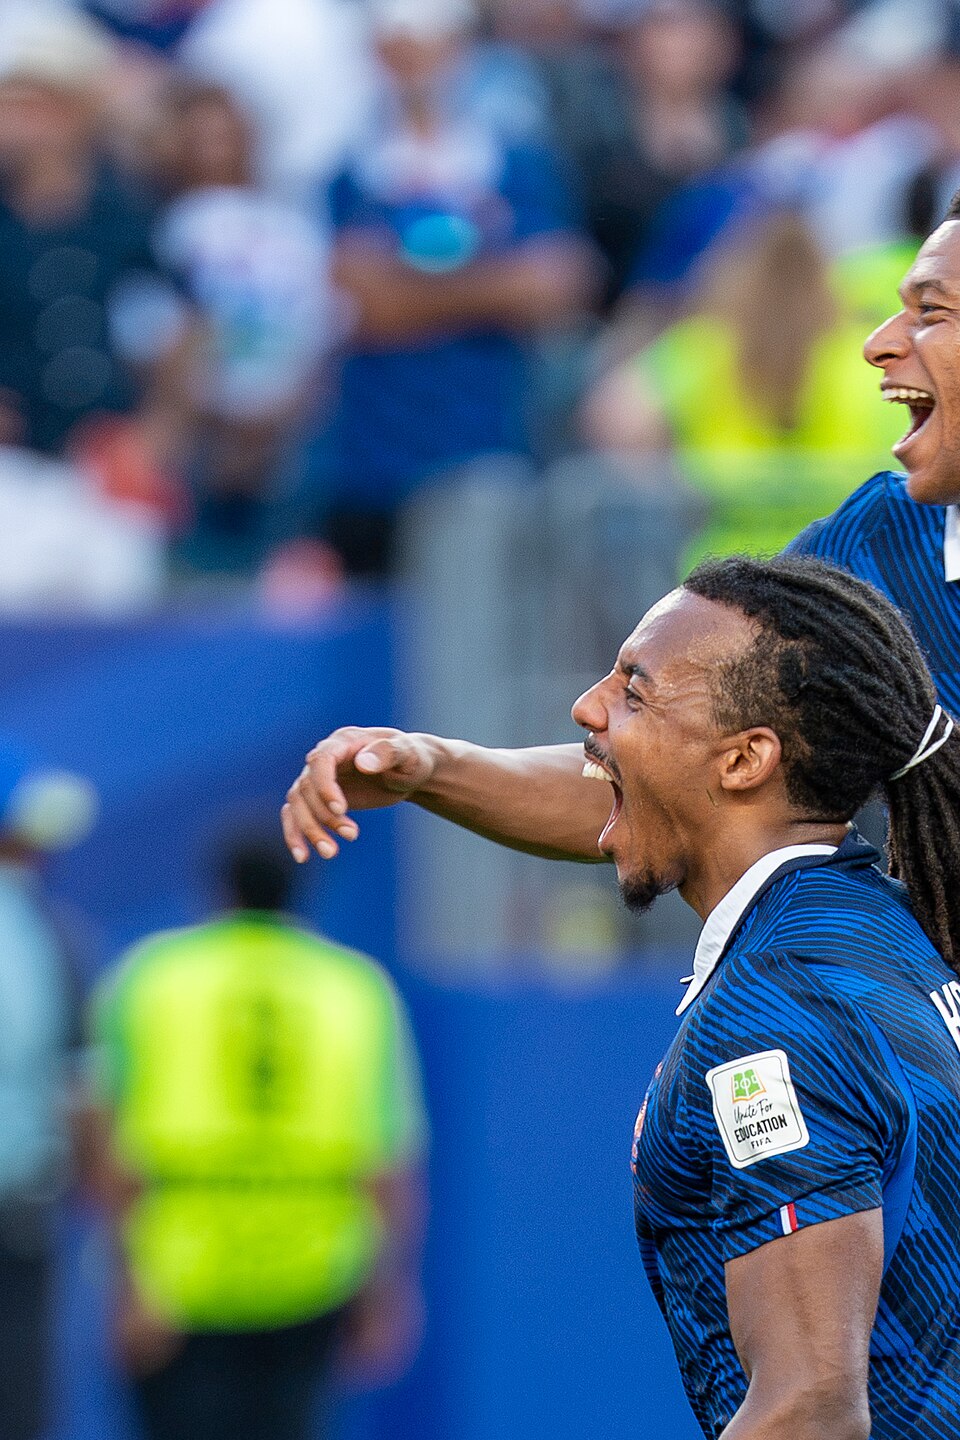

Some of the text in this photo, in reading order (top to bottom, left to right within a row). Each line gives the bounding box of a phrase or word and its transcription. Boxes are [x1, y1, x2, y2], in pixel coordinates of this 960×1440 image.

[734, 1098, 773, 1124] Unite For
[734, 1113, 788, 1143] EDUCATION
[750, 1137, 772, 1149] FIFA
